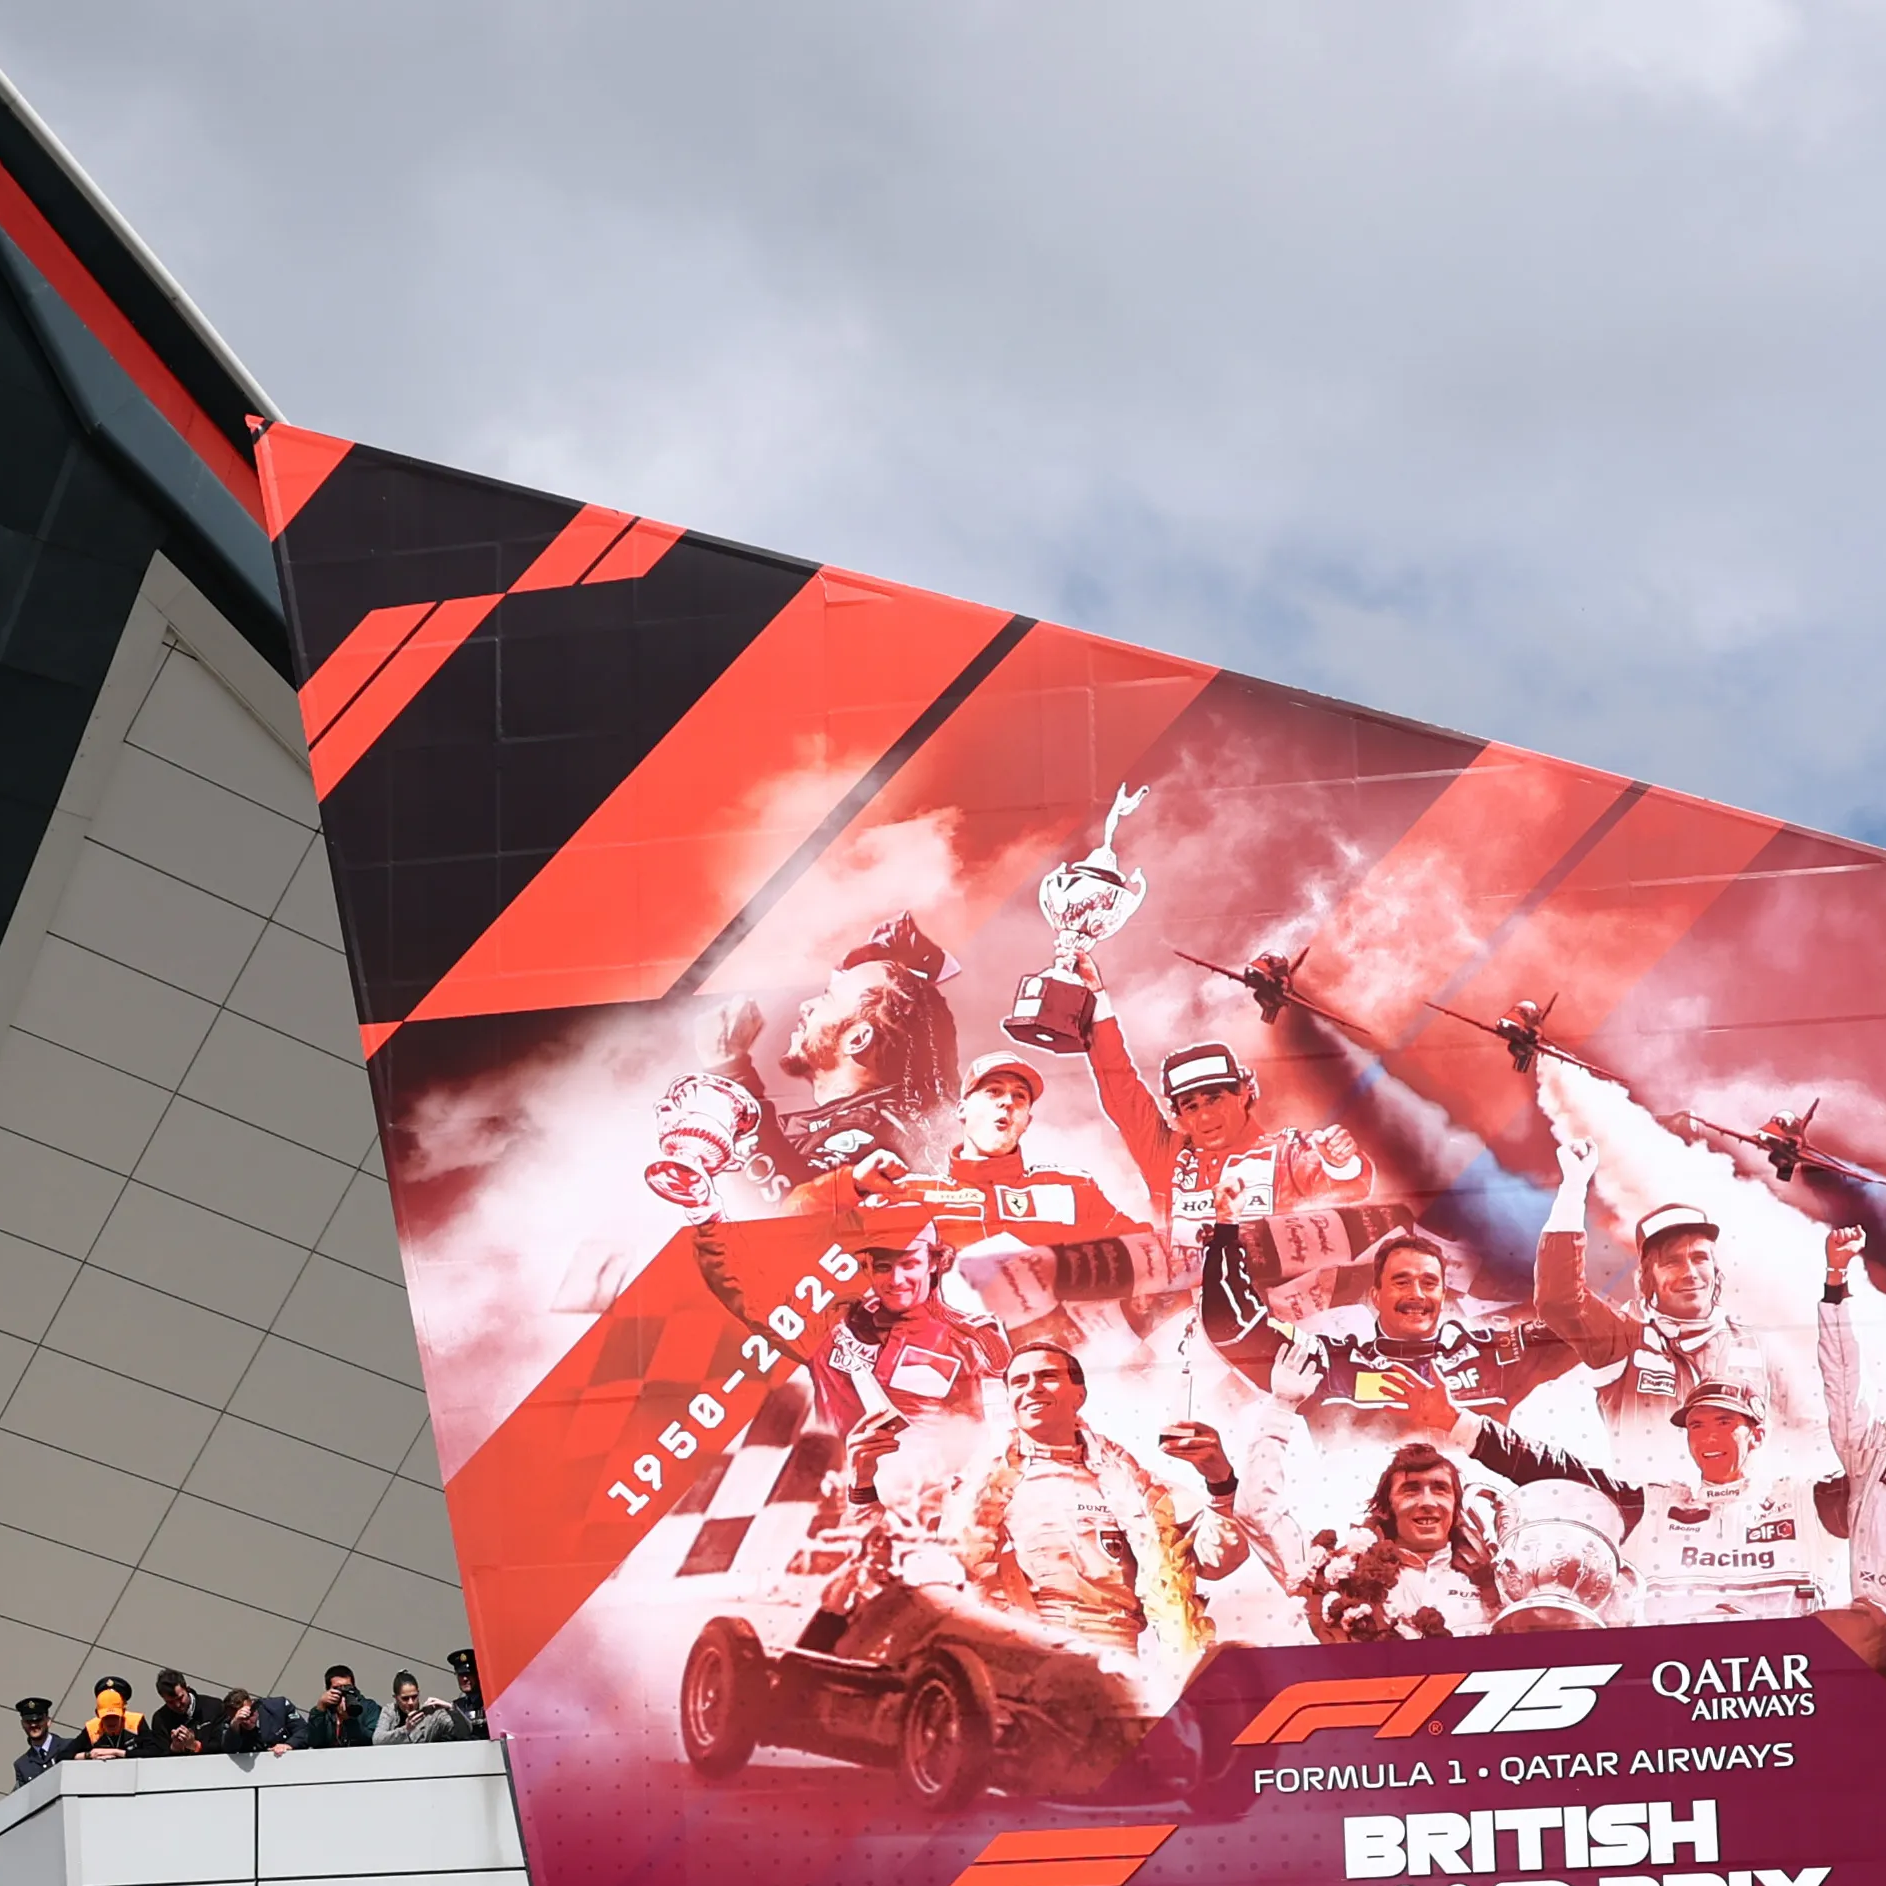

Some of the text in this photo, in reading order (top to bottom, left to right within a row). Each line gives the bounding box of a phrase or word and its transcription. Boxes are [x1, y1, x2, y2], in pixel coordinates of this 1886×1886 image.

[1182, 1195, 1267, 1212] HOA
[607, 1243, 859, 1516] 1950-2025
[1447, 1368, 1480, 1391] elf
[1707, 1486, 1741, 1498] Racing
[1077, 1504, 1111, 1513] DUNL
[1668, 1523, 1702, 1533] Racing
[1747, 1524, 1776, 1541] elf
[1681, 1546, 1776, 1569] Racing
[1447, 1589, 1481, 1598] DUN
[1651, 1653, 1813, 1703] QATAR
[1232, 1663, 1623, 1746] F1 75
[1691, 1692, 1816, 1723] AIRWAYS
[1254, 1742, 1796, 1795] FORMULA 1 QATAR AIRWAYS
[1343, 1799, 1720, 1880] BRITISH
